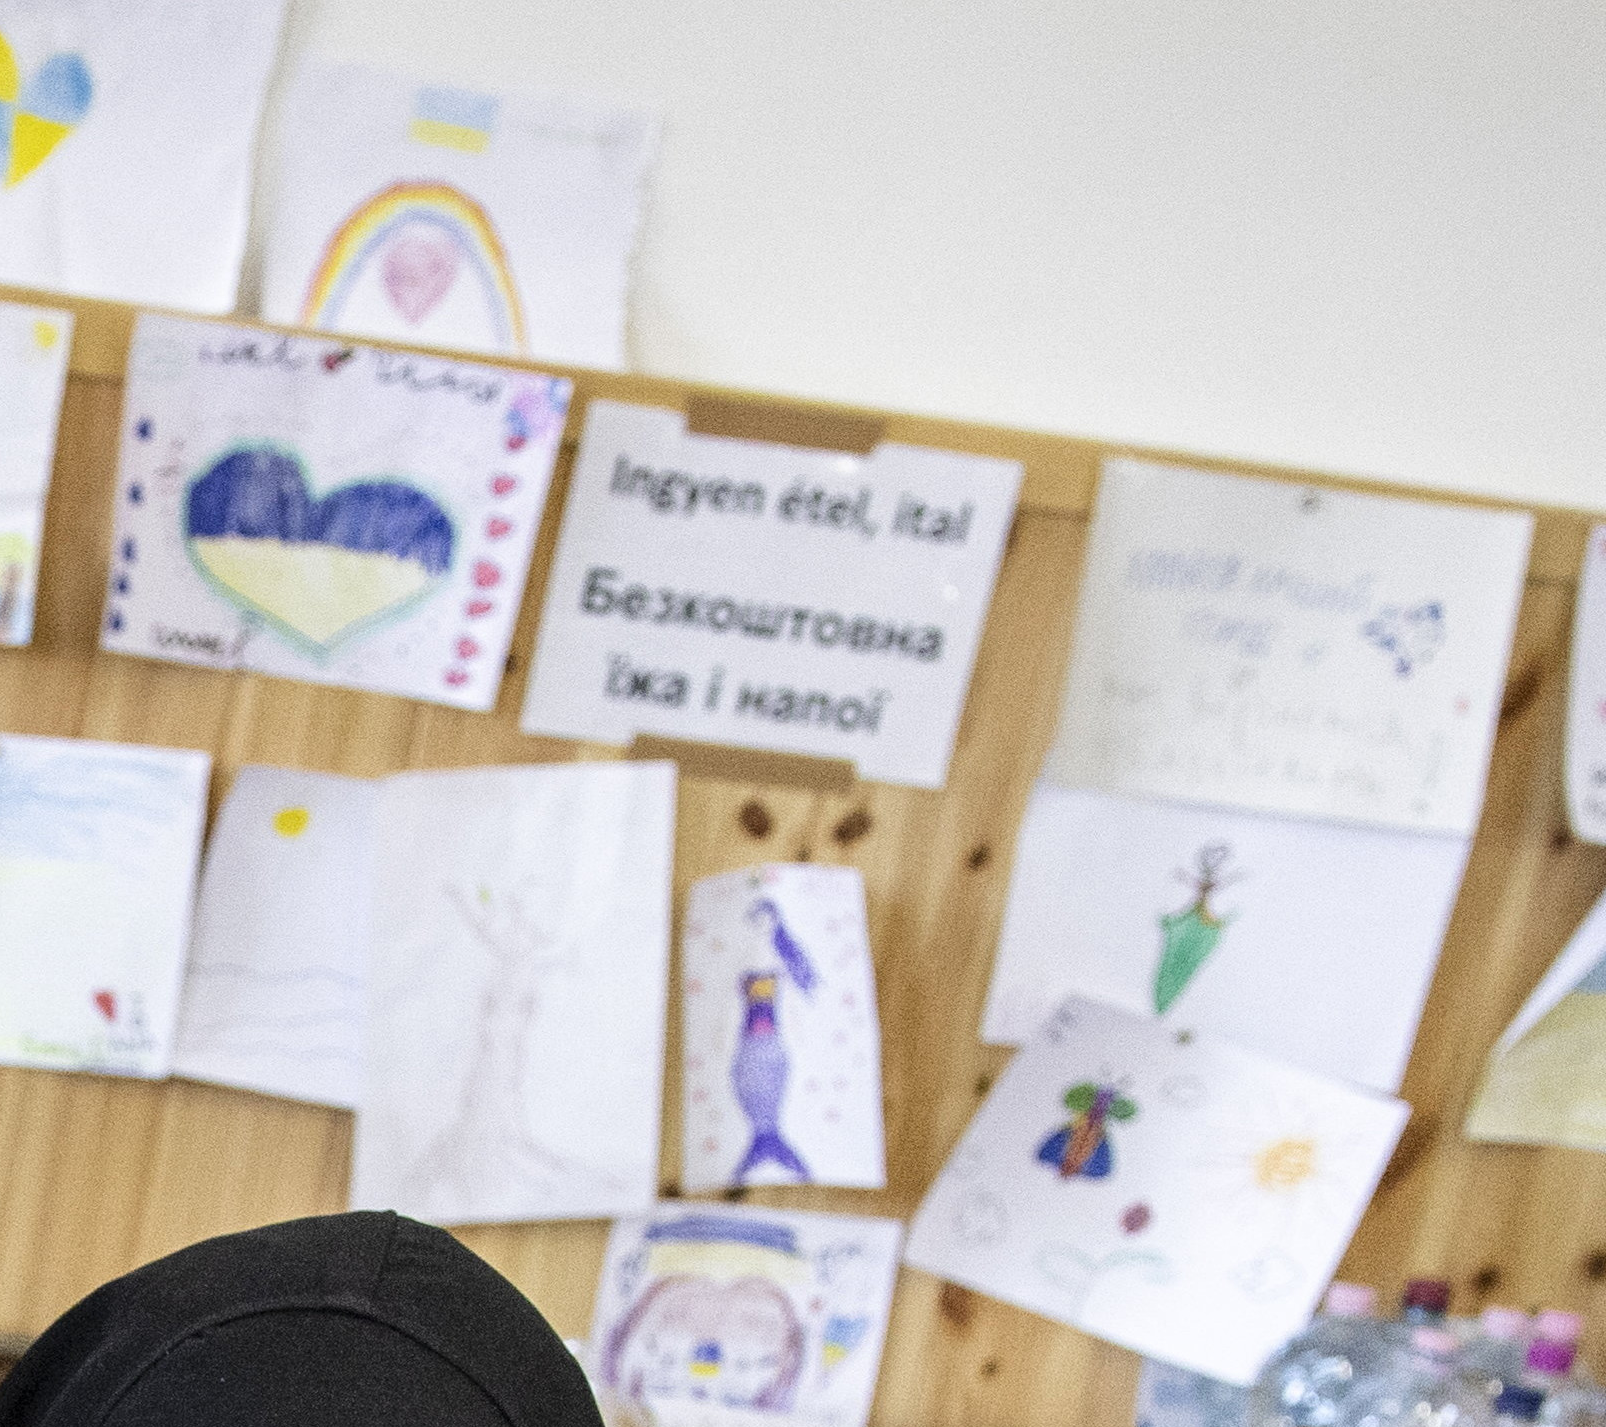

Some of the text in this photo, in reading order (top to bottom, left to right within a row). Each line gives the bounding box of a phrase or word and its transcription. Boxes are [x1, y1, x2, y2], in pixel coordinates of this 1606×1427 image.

[610, 453, 974, 545] Ingyen étel, ital
[579, 565, 944, 662] Безкоштовна
[603, 651, 690, 707] їжа
[735, 680, 889, 734] напої
